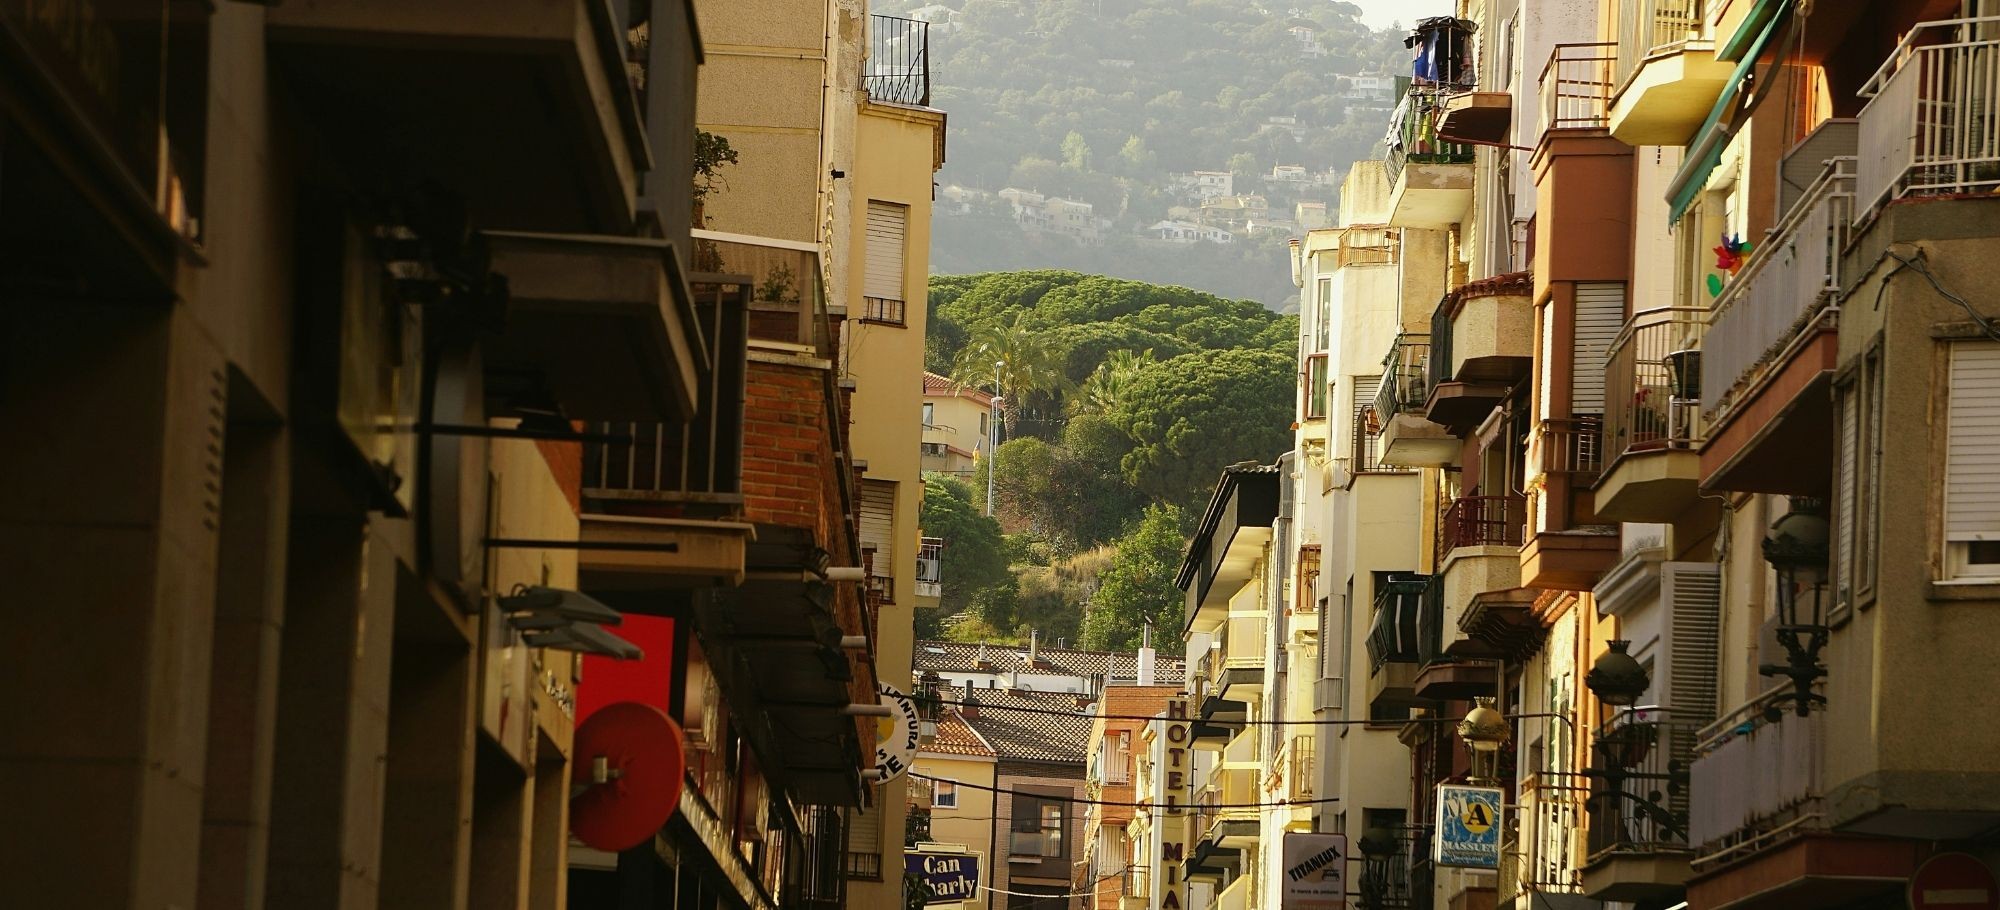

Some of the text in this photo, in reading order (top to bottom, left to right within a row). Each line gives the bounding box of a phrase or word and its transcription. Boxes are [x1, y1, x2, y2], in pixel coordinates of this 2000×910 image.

[1168, 701, 1187, 814] HOTEL
[923, 856, 960, 875] Can
[1288, 845, 1341, 882] TITANLUX
